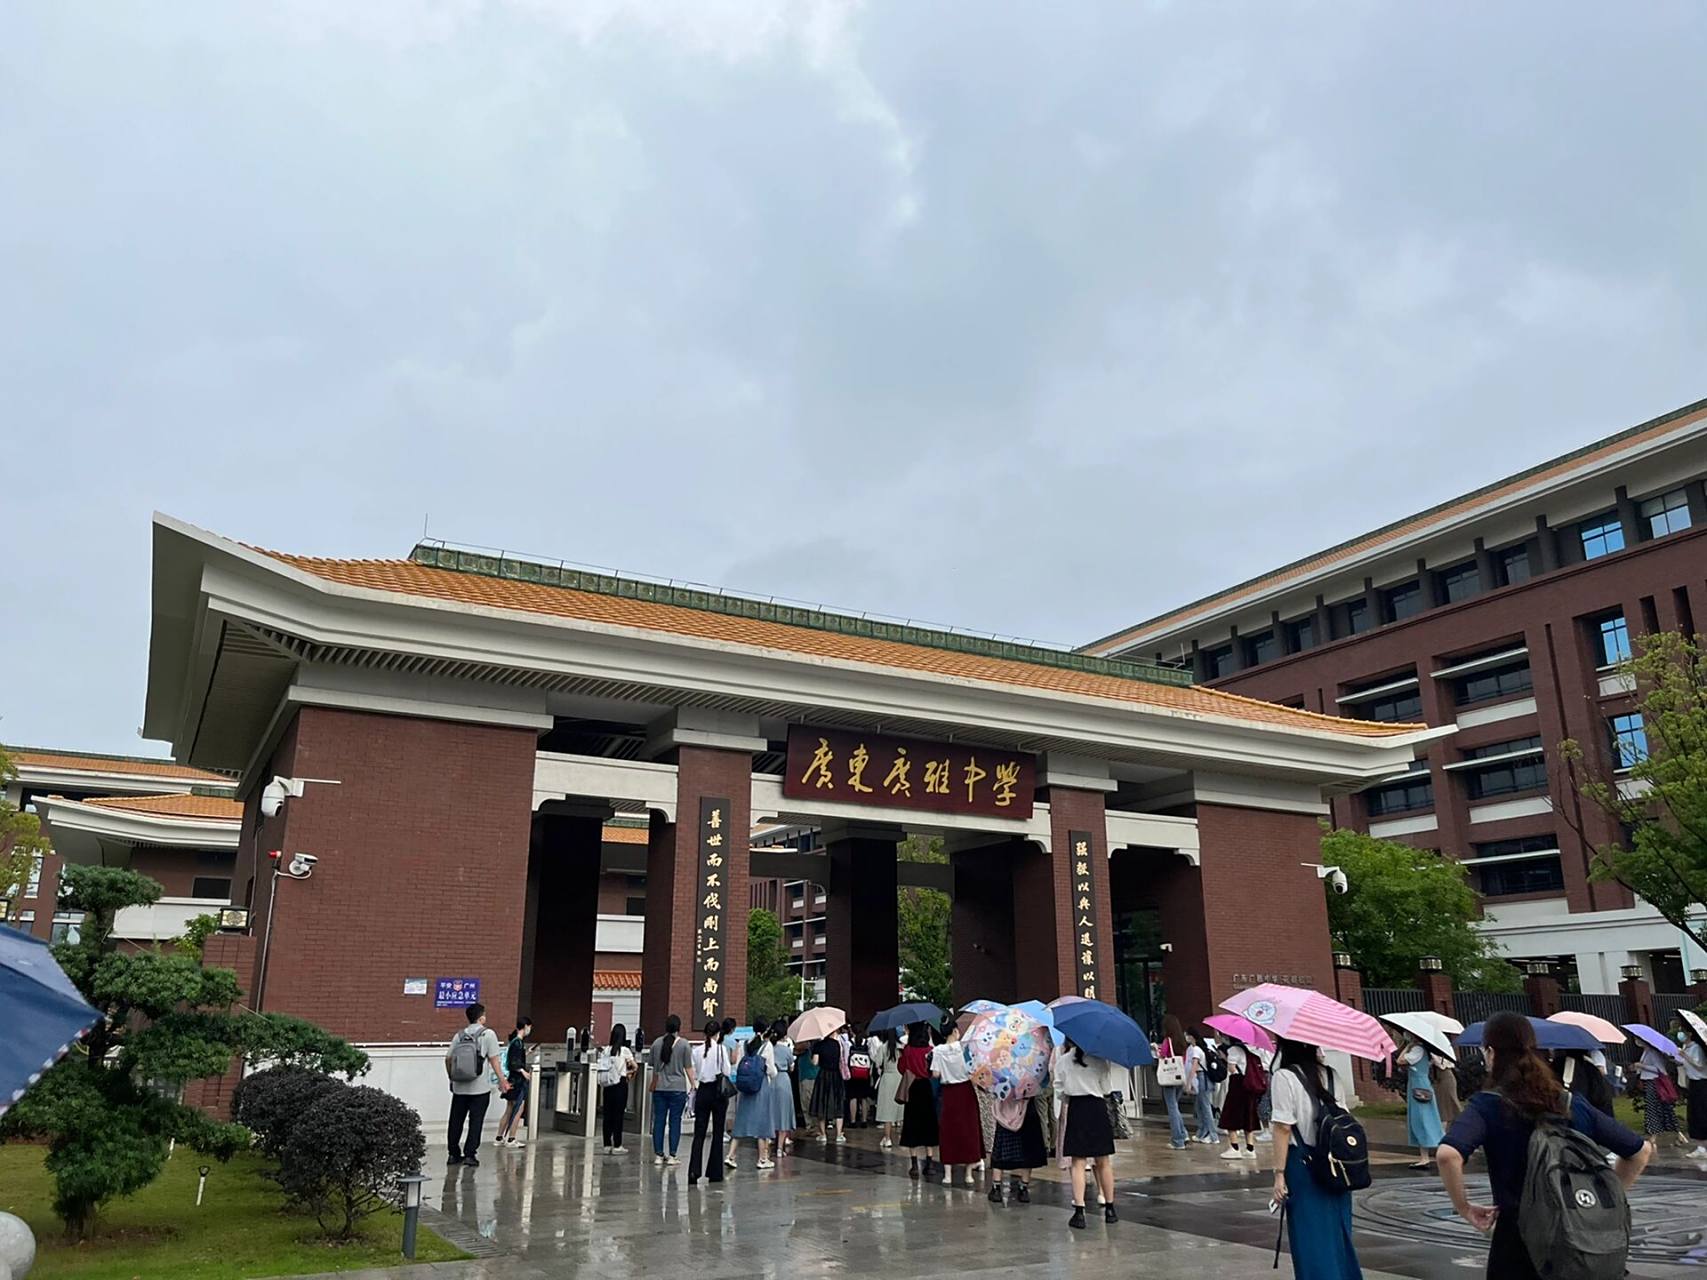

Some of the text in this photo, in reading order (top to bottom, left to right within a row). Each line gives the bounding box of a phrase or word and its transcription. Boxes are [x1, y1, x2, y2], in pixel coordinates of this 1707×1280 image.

[801, 737, 1021, 806] 廣東廣雅中學
[438, 990, 477, 1000] 最小应急单元
